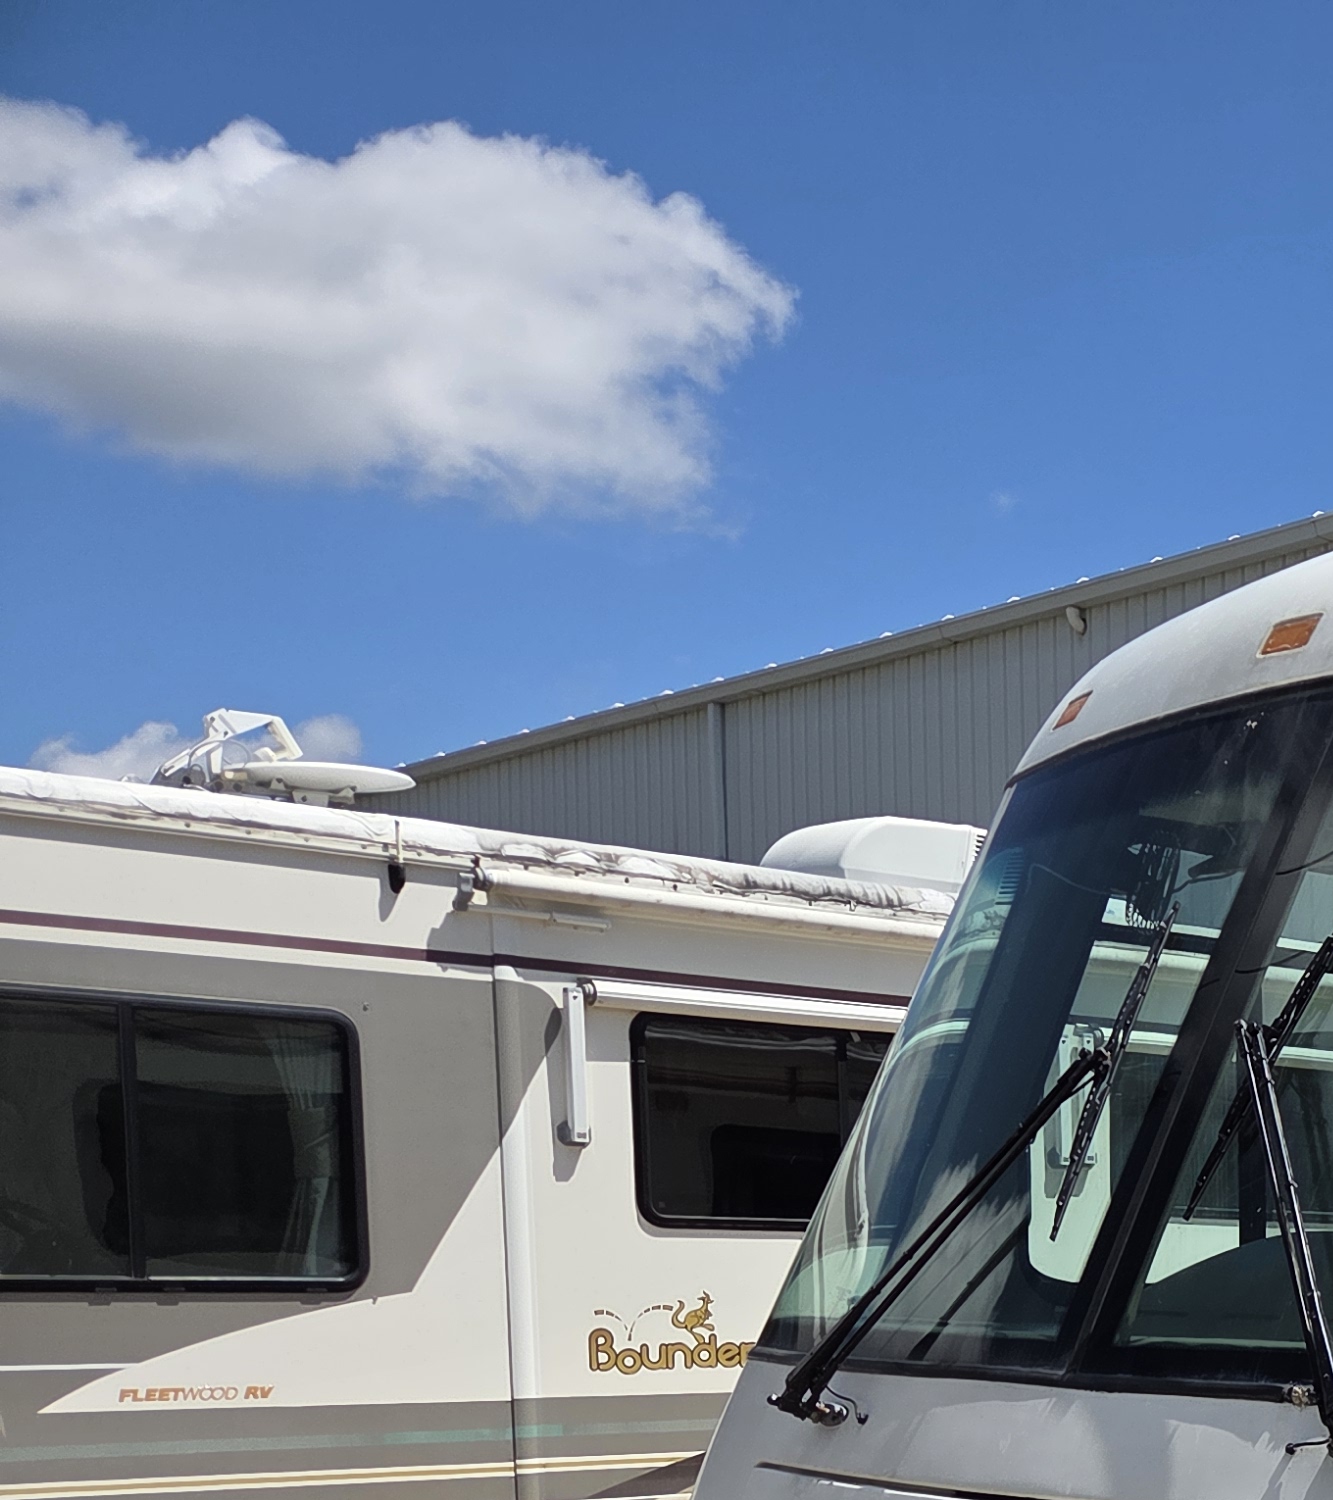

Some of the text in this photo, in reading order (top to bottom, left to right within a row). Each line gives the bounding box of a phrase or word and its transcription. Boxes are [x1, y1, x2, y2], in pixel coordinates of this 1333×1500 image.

[588, 1328, 757, 1375] Bounder
[118, 1385, 274, 1403] FLEETWOOD RV
